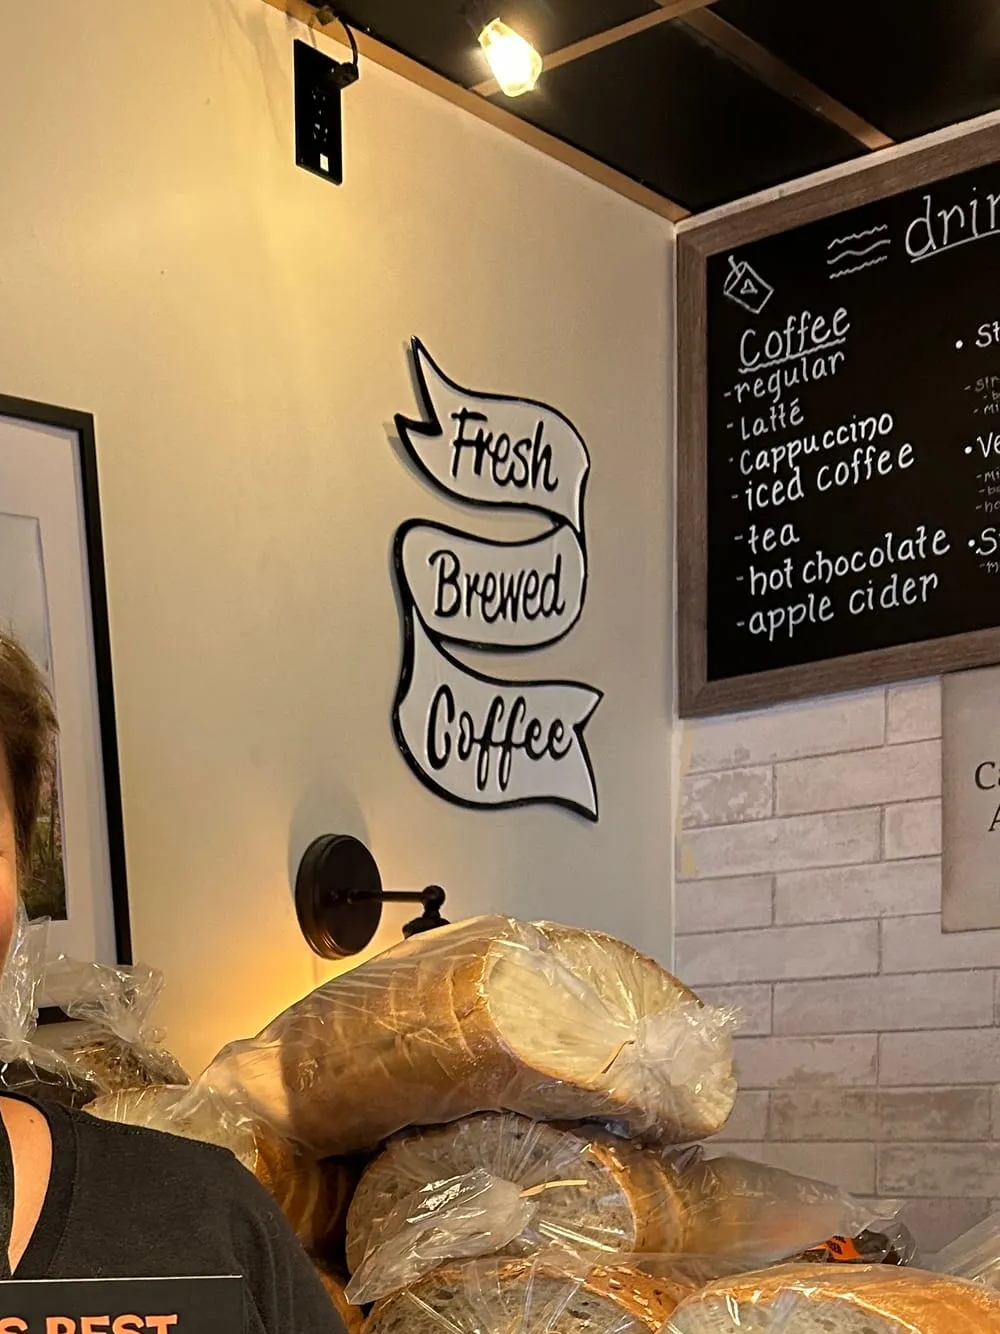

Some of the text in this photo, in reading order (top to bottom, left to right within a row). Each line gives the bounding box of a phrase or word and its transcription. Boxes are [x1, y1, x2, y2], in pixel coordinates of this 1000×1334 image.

[740, 307, 850, 367] Coffee
[450, 407, 558, 491] Fresh
[816, 442, 915, 492] coffee
[802, 525, 951, 585] chocolate
[428, 549, 565, 623] Brewed
[848, 572, 939, 616] cider
[426, 684, 574, 791] Coffee
